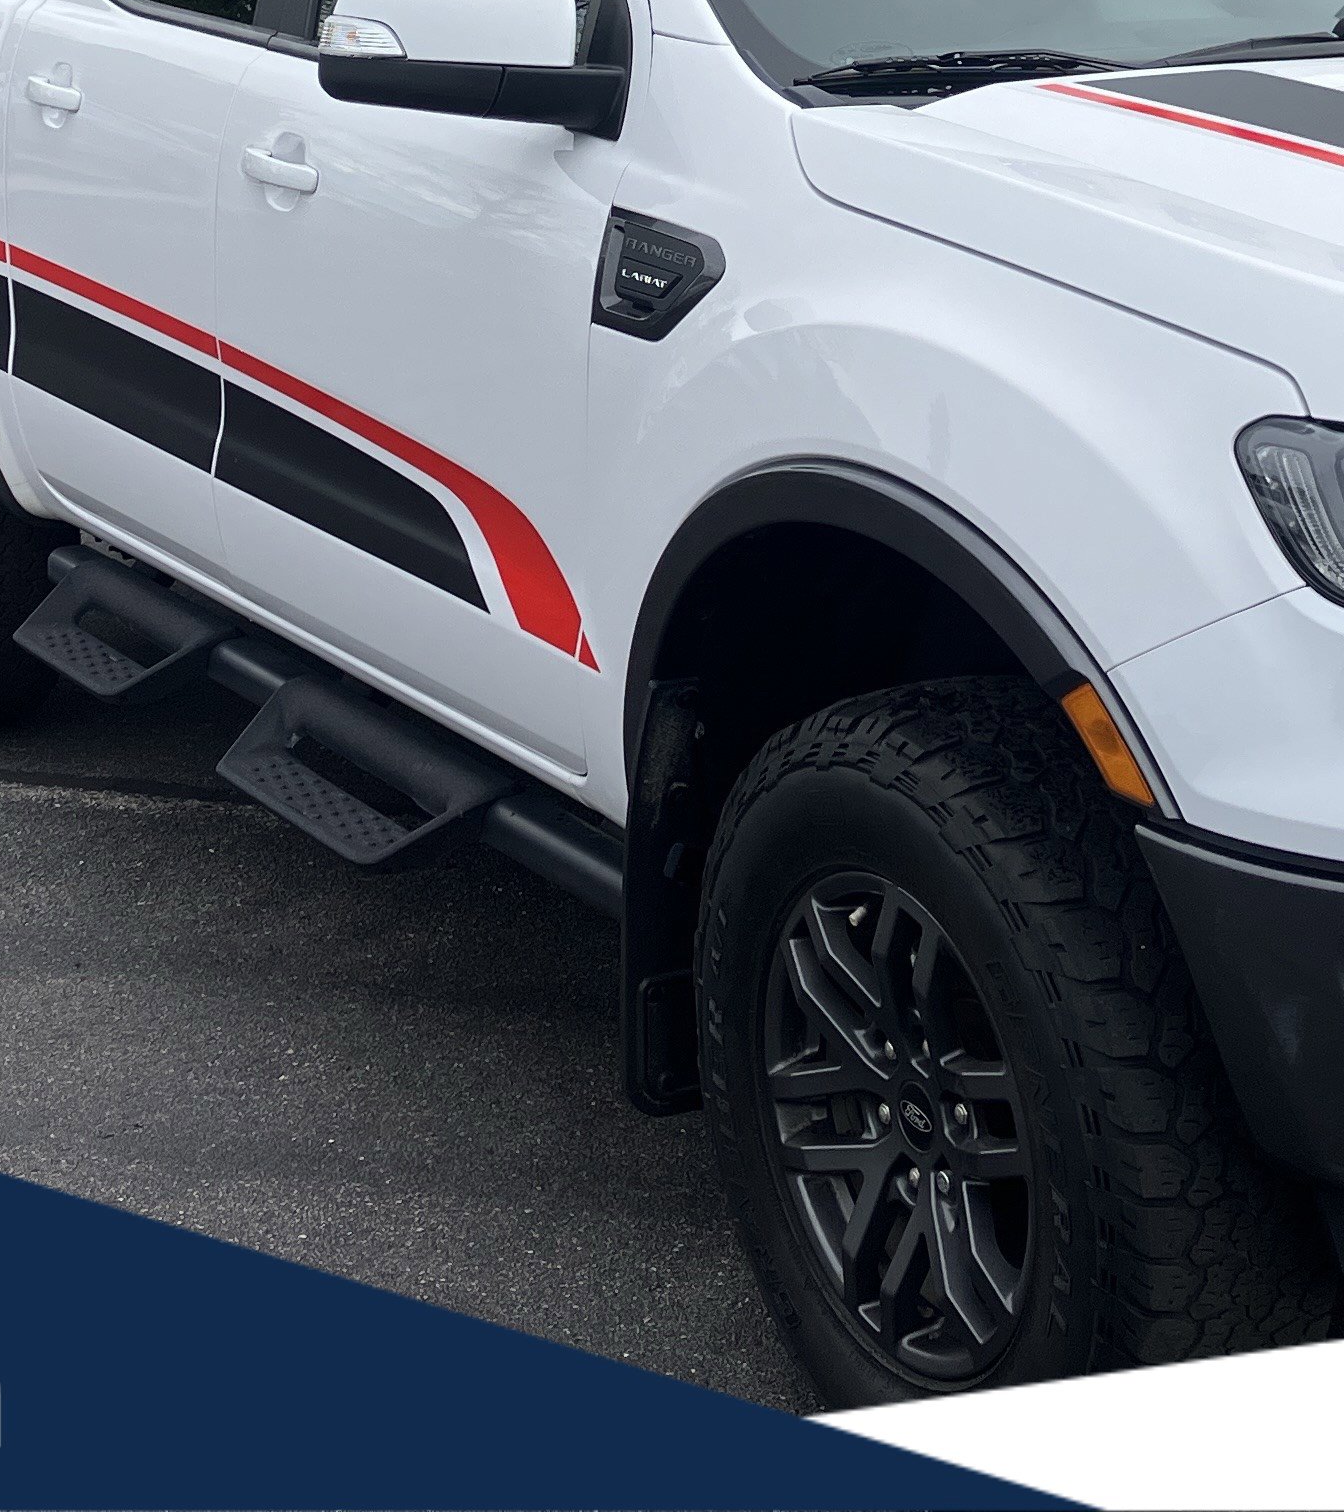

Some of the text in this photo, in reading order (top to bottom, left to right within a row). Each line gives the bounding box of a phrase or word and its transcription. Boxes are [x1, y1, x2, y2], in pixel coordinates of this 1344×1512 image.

[625, 238, 697, 268] RANGER
[621, 268, 669, 289] LARIAT
[904, 1103, 927, 1129] Ford
